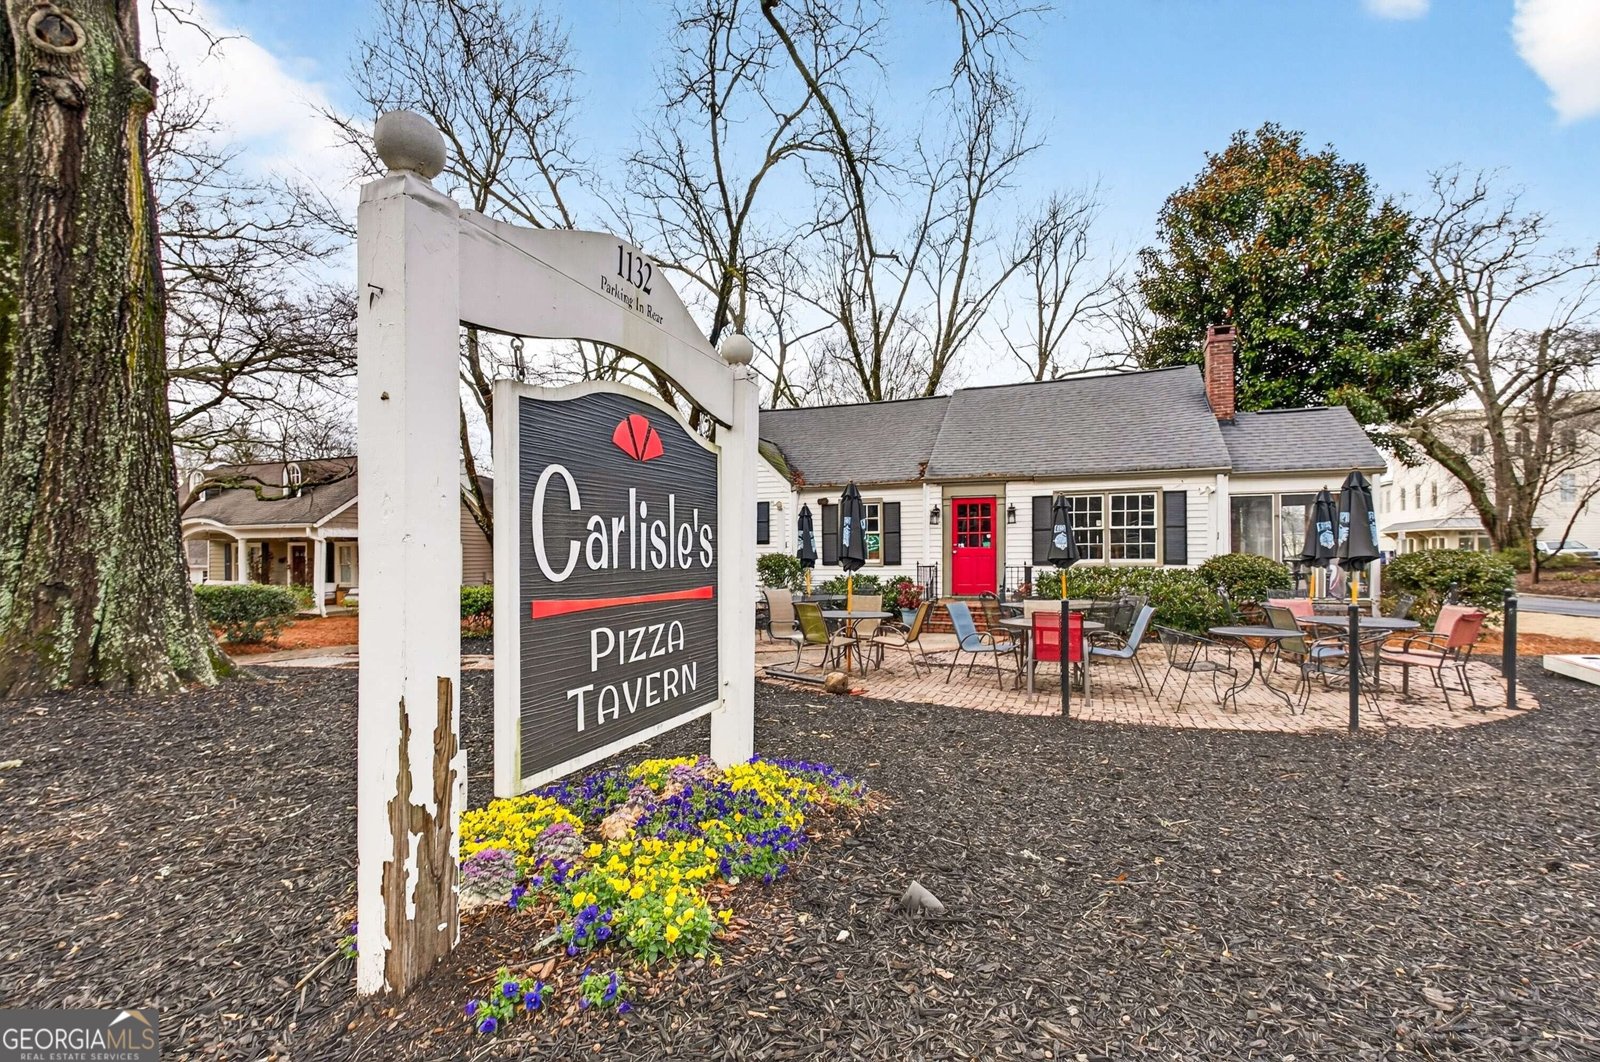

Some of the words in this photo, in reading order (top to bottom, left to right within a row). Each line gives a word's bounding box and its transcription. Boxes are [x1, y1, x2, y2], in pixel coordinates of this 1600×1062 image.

[617, 244, 652, 296] 1132
[600, 274, 634, 310] Parking
[635, 296, 645, 314] In
[646, 304, 664, 325] Rear
[531, 463, 713, 582] Carlisle's
[590, 620, 685, 672] PIZZA
[566, 661, 697, 732] TAVERN
